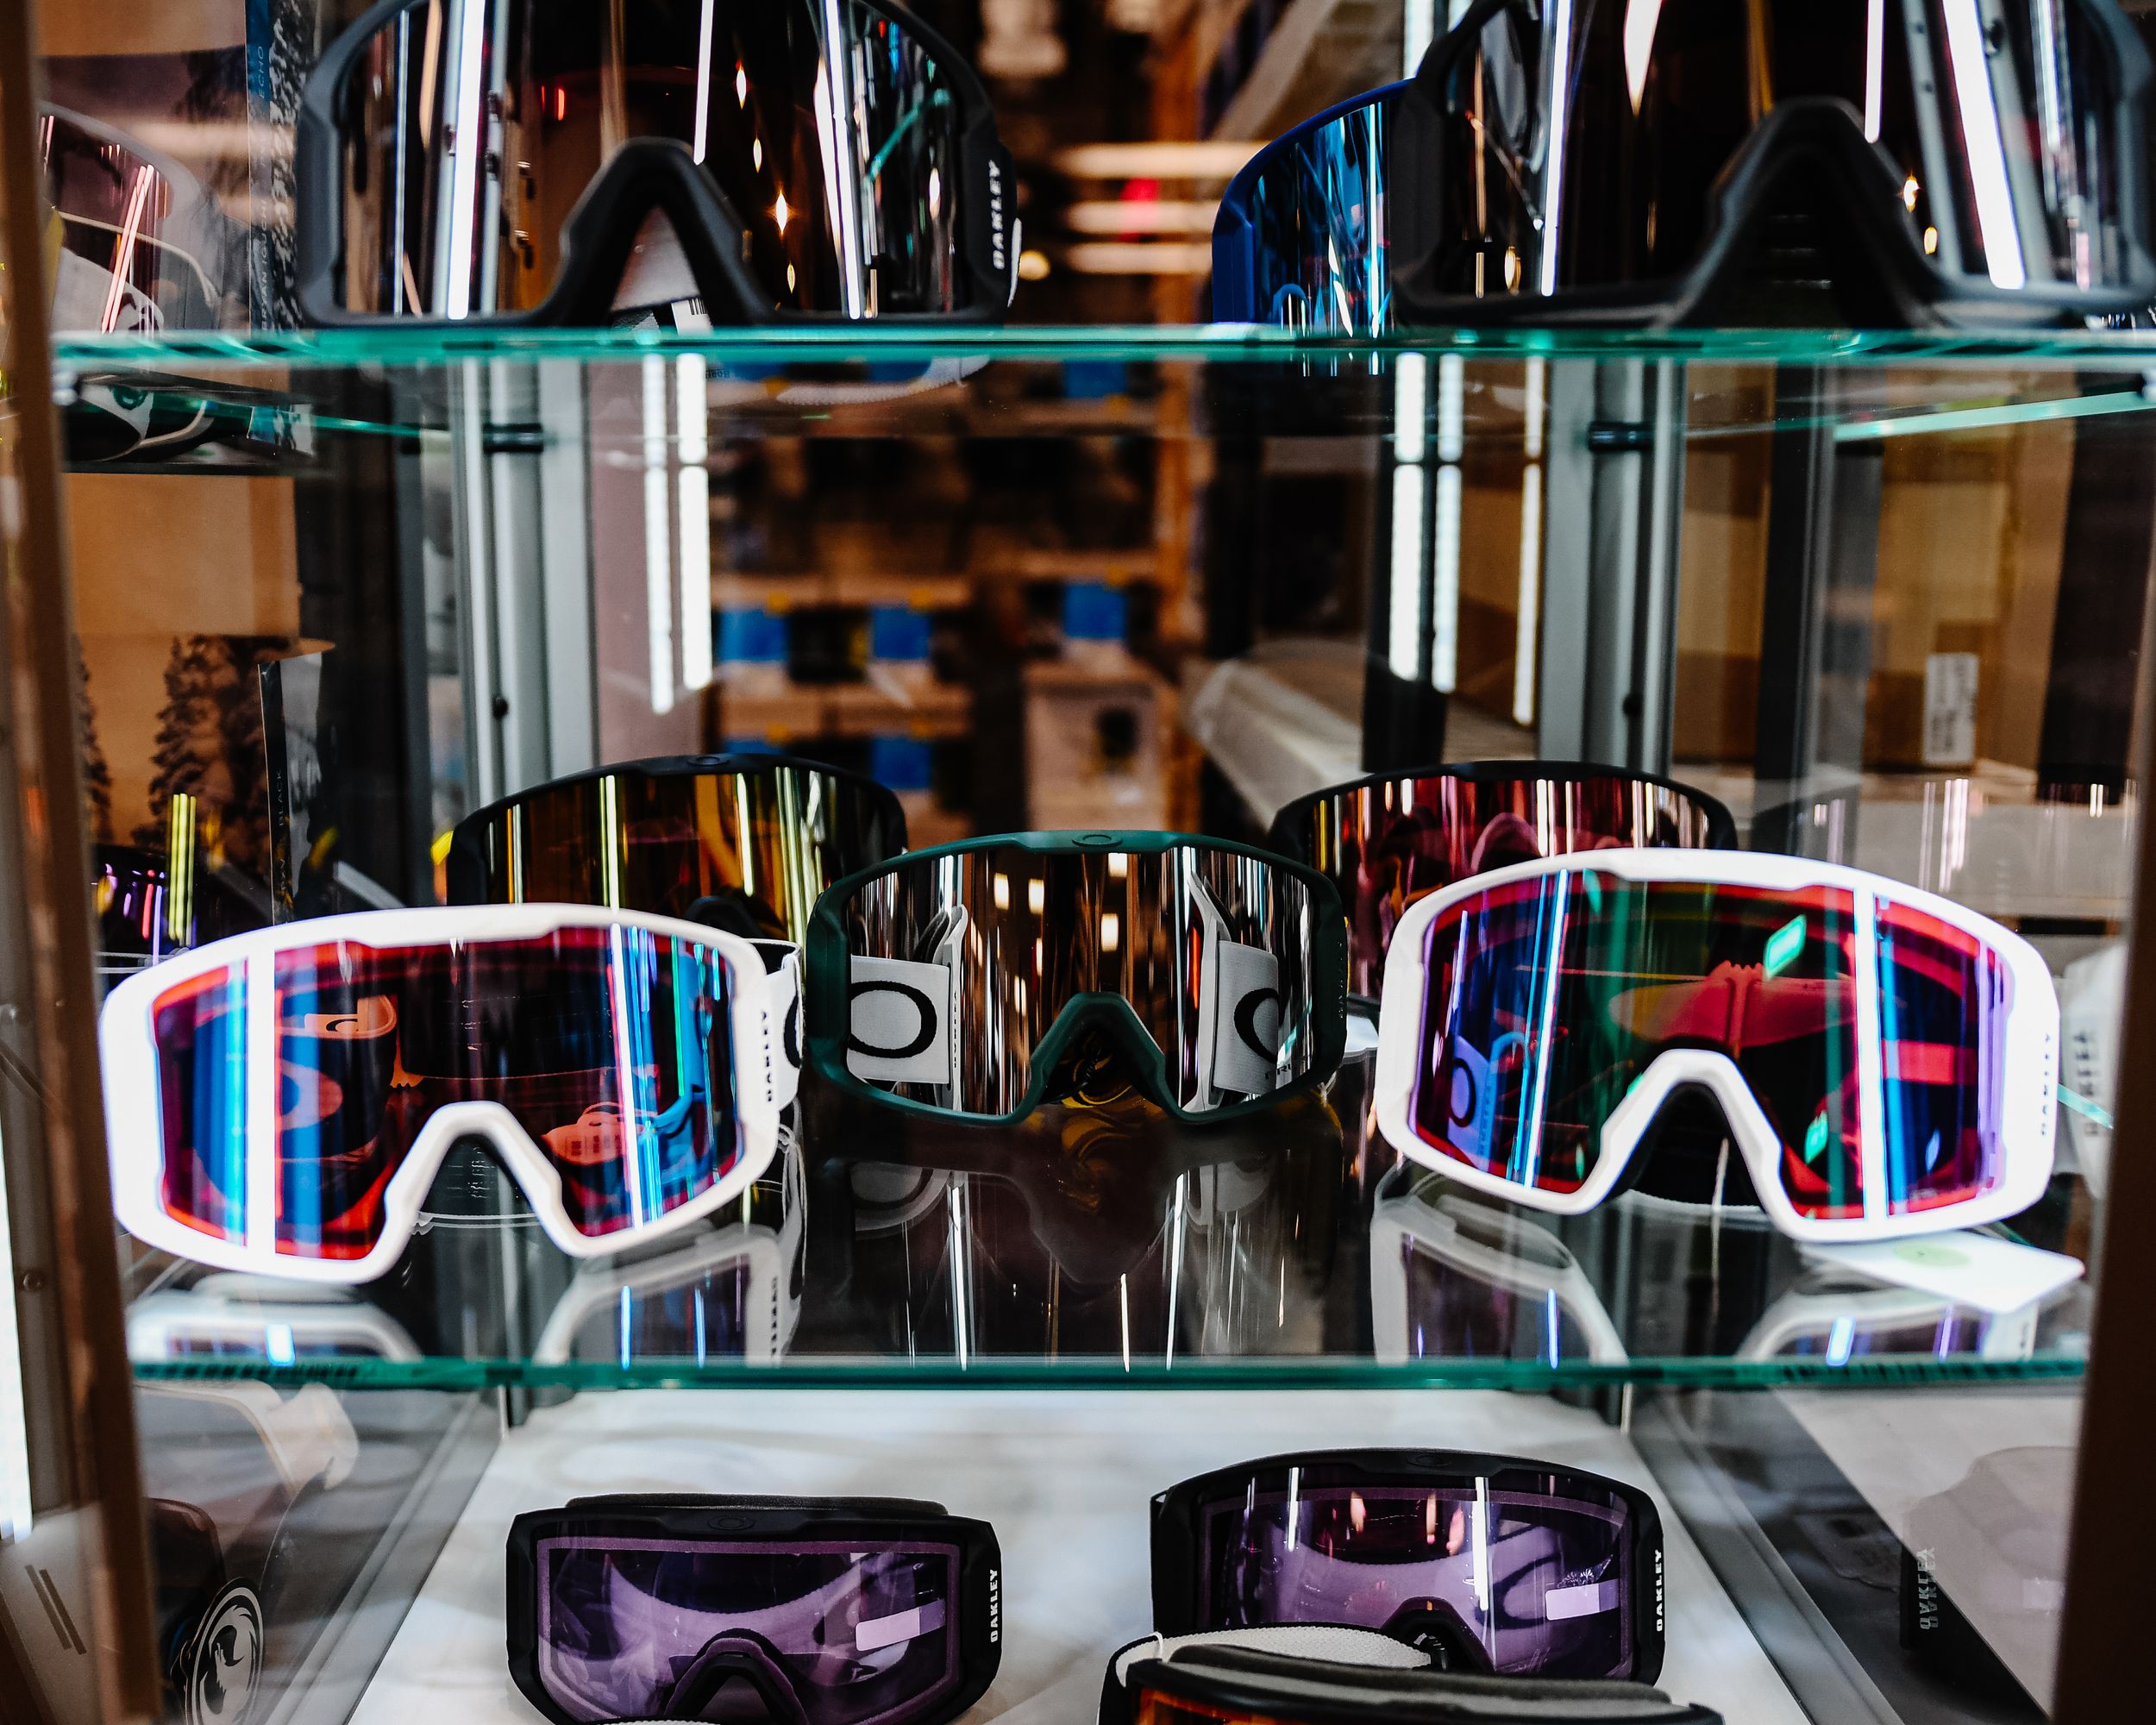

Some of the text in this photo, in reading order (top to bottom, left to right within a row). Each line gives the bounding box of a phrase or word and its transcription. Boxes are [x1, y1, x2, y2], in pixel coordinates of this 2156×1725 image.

[257, 46, 266, 99] ECHO
[987, 159, 1006, 270] OAKLEY
[260, 271, 269, 331] BRYAN
[276, 768, 285, 827] BLACK
[989, 1568, 999, 1643] OAKLEY
[1654, 1549, 1664, 1632] OAKLEY
